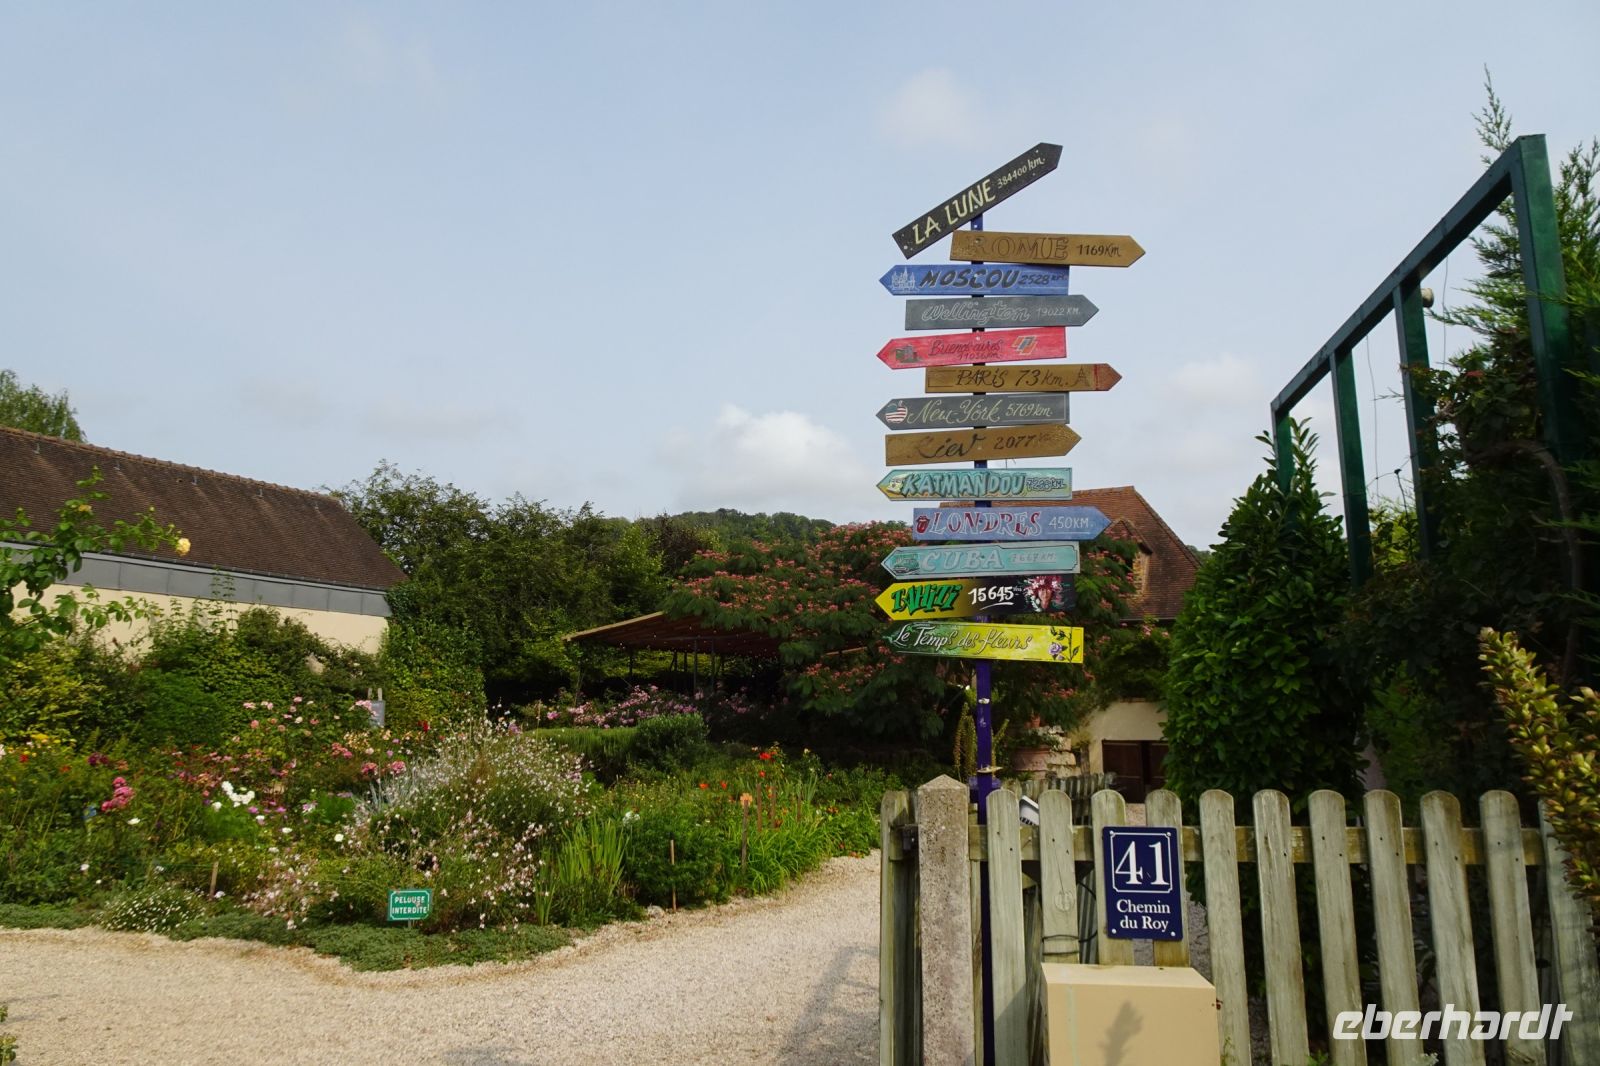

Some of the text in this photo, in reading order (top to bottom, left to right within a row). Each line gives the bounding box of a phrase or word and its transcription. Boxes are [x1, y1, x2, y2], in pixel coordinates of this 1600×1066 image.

[912, 215, 941, 245] LA
[945, 178, 996, 224] LUNE
[964, 235, 1069, 260] ROME
[919, 268, 1020, 289] MOSCOU
[921, 300, 1030, 325] Wellington
[1014, 369, 1040, 387] 73
[994, 434, 1037, 450] 2077
[901, 470, 1026, 497] KATMANDOU
[930, 511, 1042, 537] LONDRES
[920, 548, 1004, 571] CUBA
[894, 624, 1033, 655] Le Temps des fleurs
[1114, 841, 1170, 886] 41
[392, 906, 428, 914] INTERDITE
[394, 896, 426, 904] PELOUSE
[1116, 898, 1171, 915] Chemin
[1120, 916, 1169, 931] du Roy
